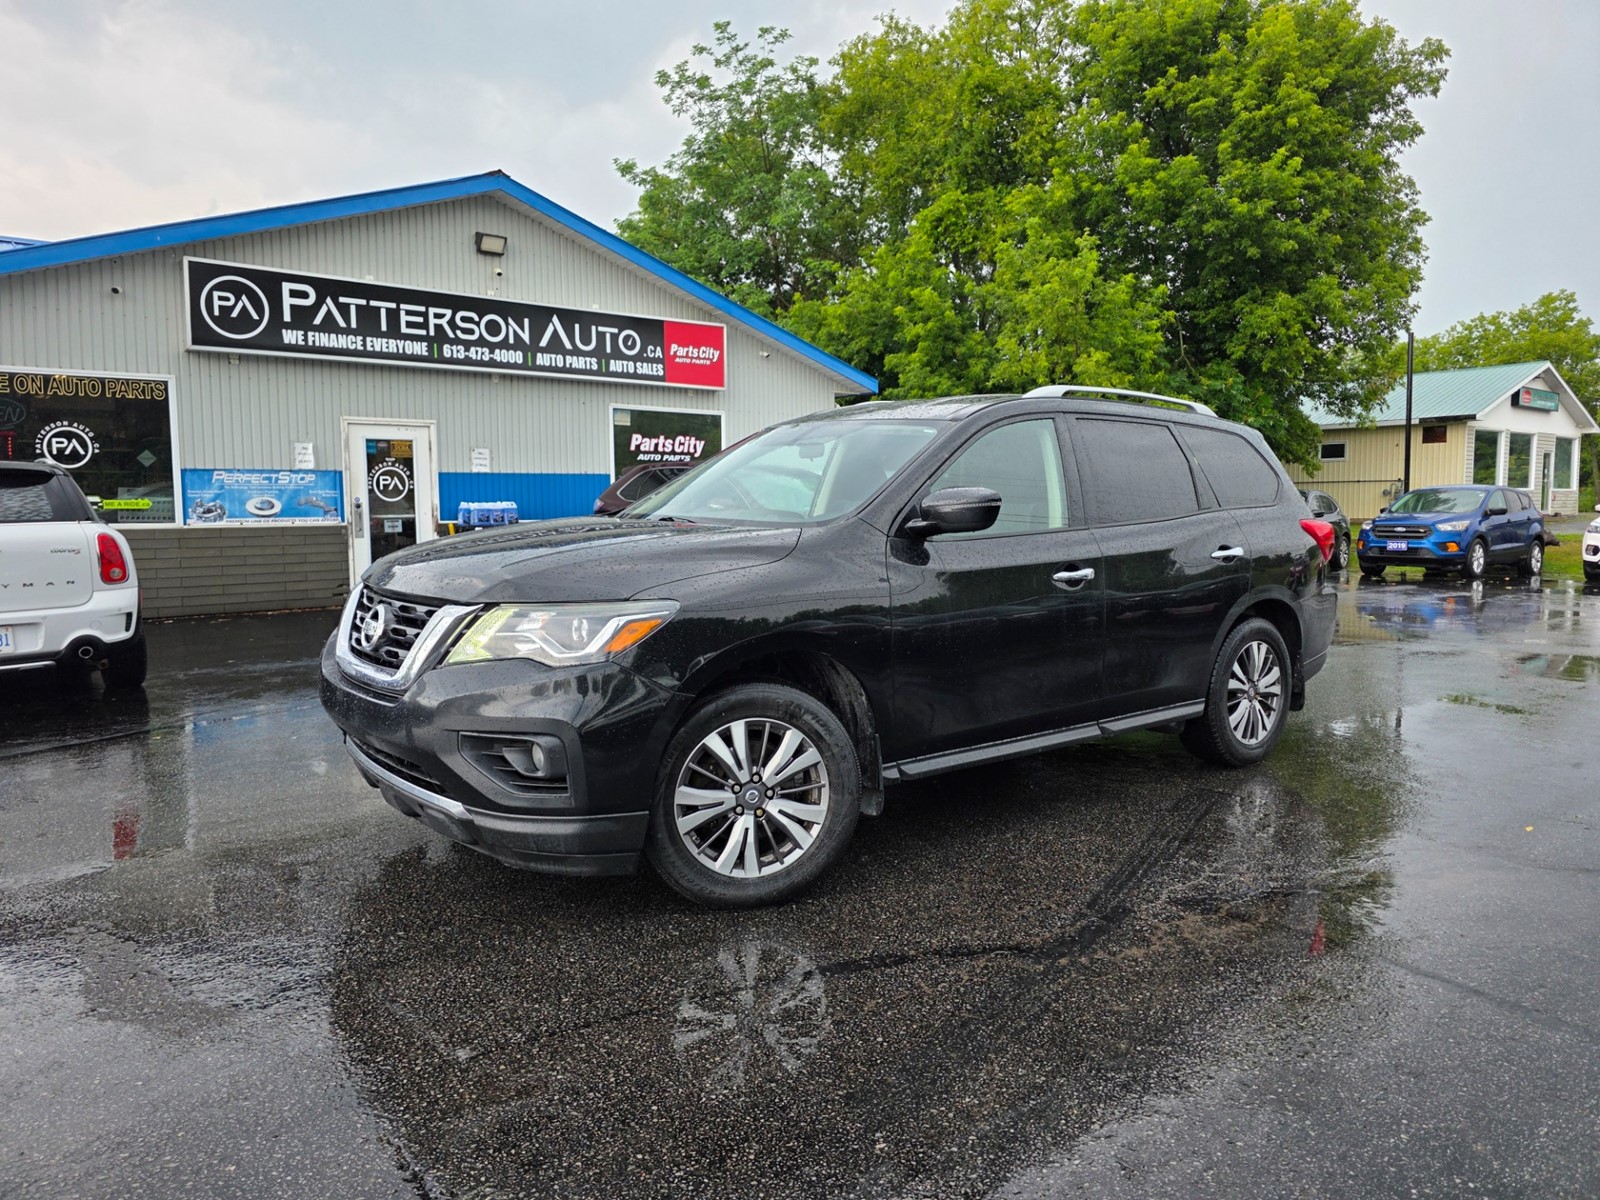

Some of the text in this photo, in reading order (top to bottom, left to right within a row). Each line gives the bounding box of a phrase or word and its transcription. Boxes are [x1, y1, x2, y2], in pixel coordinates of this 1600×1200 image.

[212, 290, 260, 320] PA
[281, 281, 530, 346] PATTERSON
[539, 313, 641, 356] AUTO
[282, 329, 428, 356] WE FINANCE EVERYONE
[443, 344, 523, 364] 613-473-4000
[536, 353, 598, 371] AUTO PARTS
[609, 359, 664, 376] AUTO SALES
[14, 374, 44, 394] ON
[48, 375, 102, 396] AUTO
[105, 379, 166, 400] PARTS
[35, 421, 69, 454] PATTERSON
[72, 422, 95, 437] AUTO
[51, 437, 86, 455] PA
[637, 453, 661, 461] AUTO
[379, 475, 404, 490] PA
